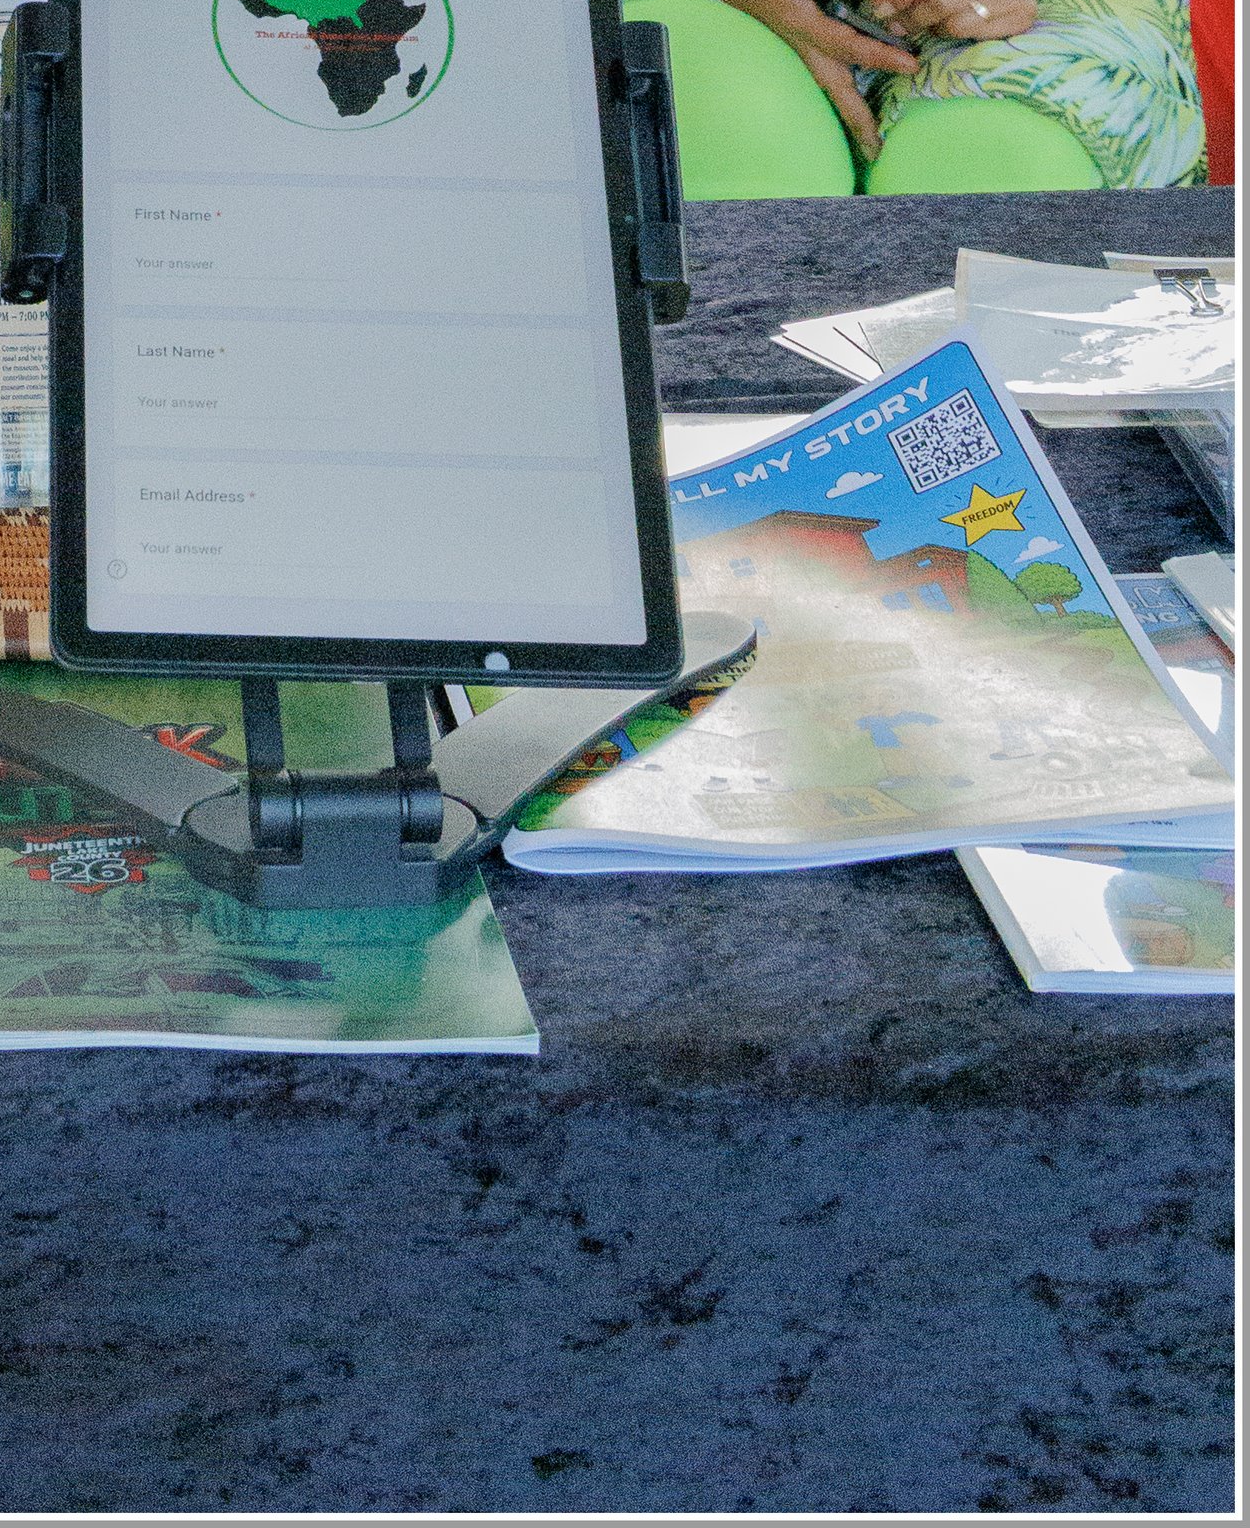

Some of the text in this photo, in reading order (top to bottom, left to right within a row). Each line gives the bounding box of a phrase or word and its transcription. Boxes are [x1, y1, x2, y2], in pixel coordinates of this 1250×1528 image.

[255, 31, 275, 39] The
[135, 208, 212, 221] First Name
[135, 257, 214, 270] Your answer
[19, 311, 38, 321] 7:00
[137, 345, 215, 358] Last Name
[138, 396, 218, 409] Your answer
[670, 376, 930, 505] LL MY STORY
[140, 488, 245, 502] Email Address
[961, 499, 1016, 526] FREEDOM
[141, 542, 223, 555] Your answer
[58, 850, 122, 862] COUNTY
[51, 858, 130, 884] 26
